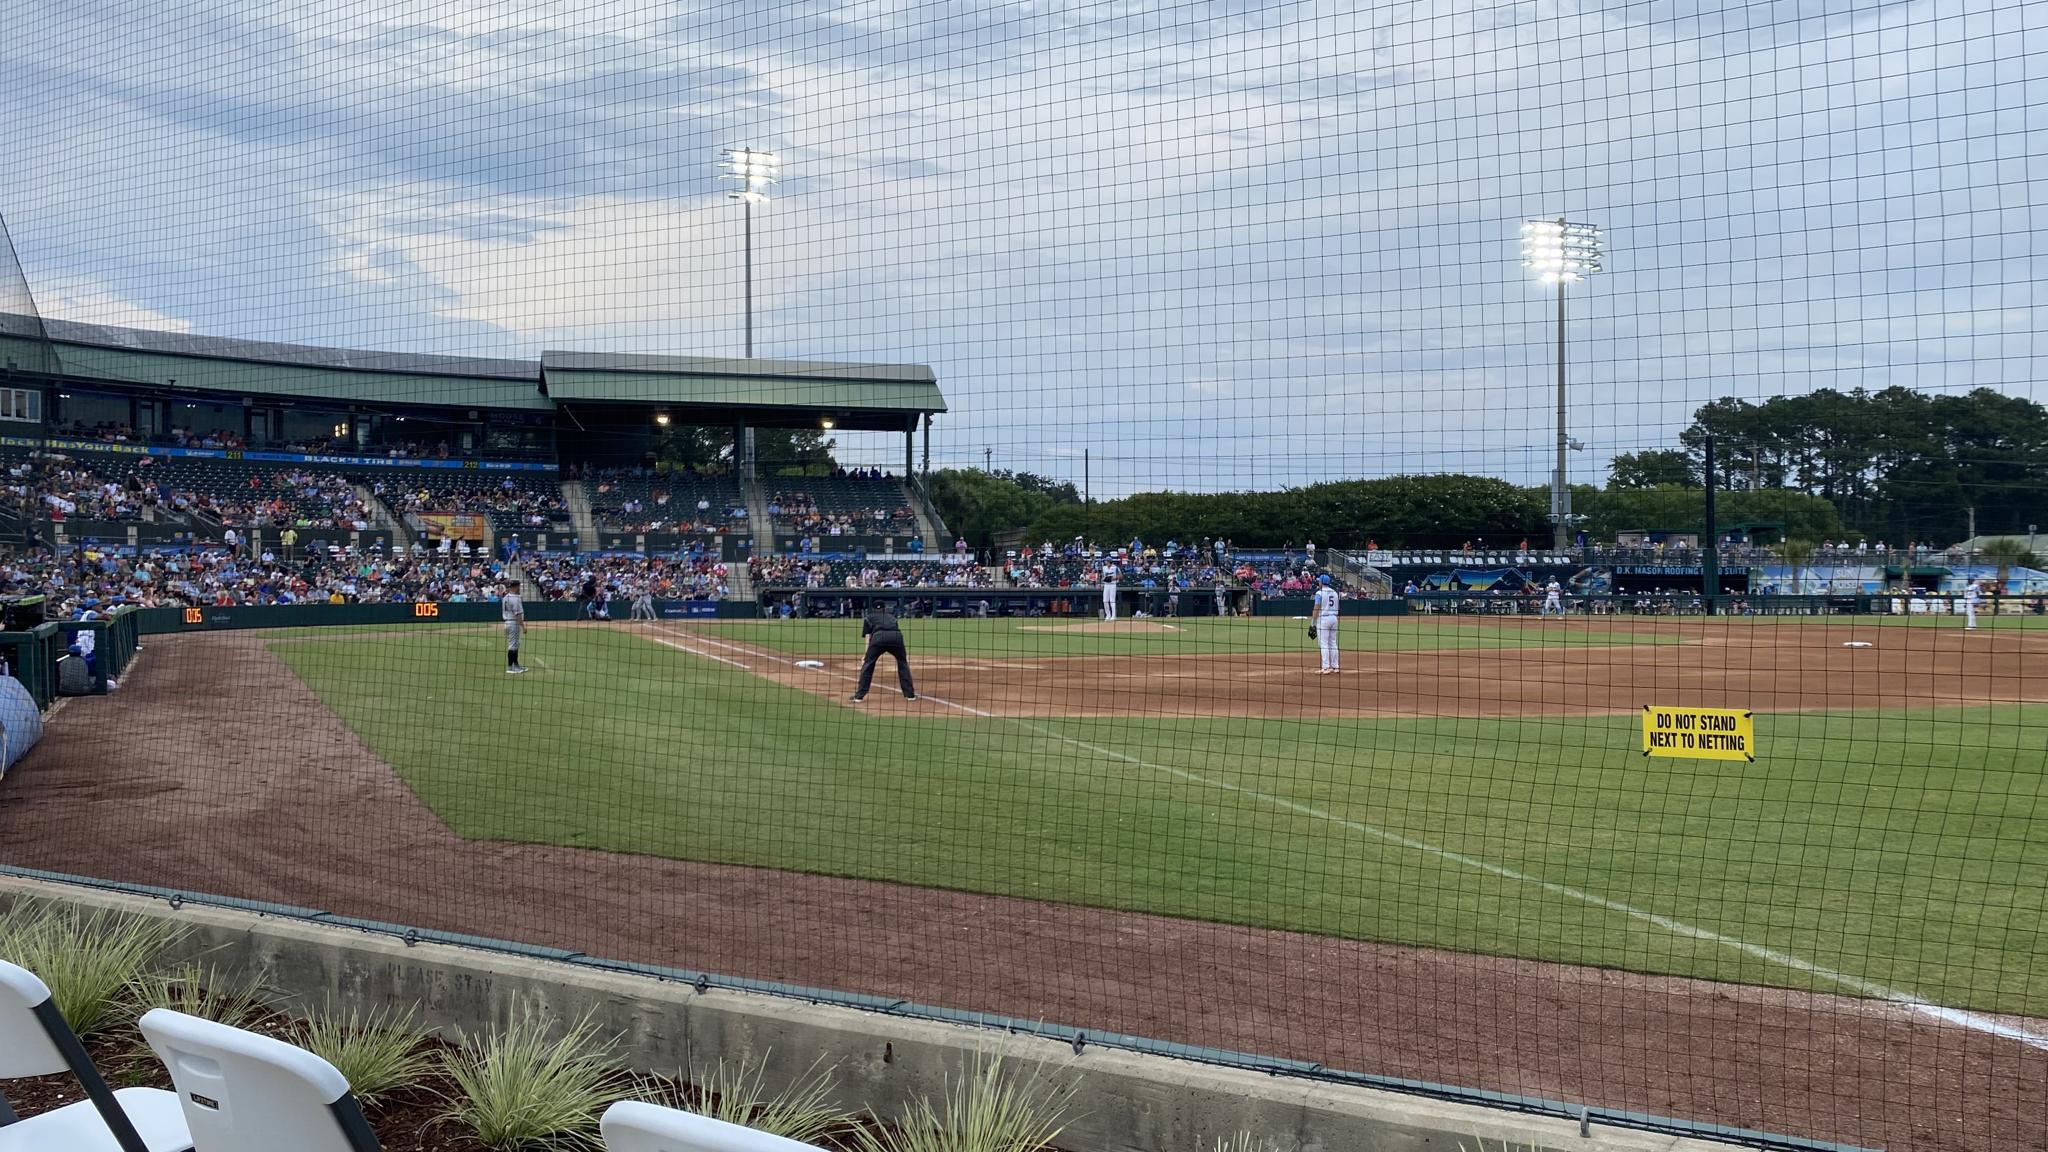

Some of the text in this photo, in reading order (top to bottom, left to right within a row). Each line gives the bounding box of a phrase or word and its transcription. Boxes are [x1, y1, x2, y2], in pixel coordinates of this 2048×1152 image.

[227, 451, 241, 459] 211
[304, 455, 359, 464] BLACK'S
[1635, 566, 1662, 575] MASON
[1664, 566, 1699, 575] ROOFING
[1724, 567, 1747, 575] SUITE
[1328, 596, 1335, 607] 5
[1657, 713, 1736, 731] DO NOT STAND
[1649, 732, 1744, 751] NEXT TO NETTING
